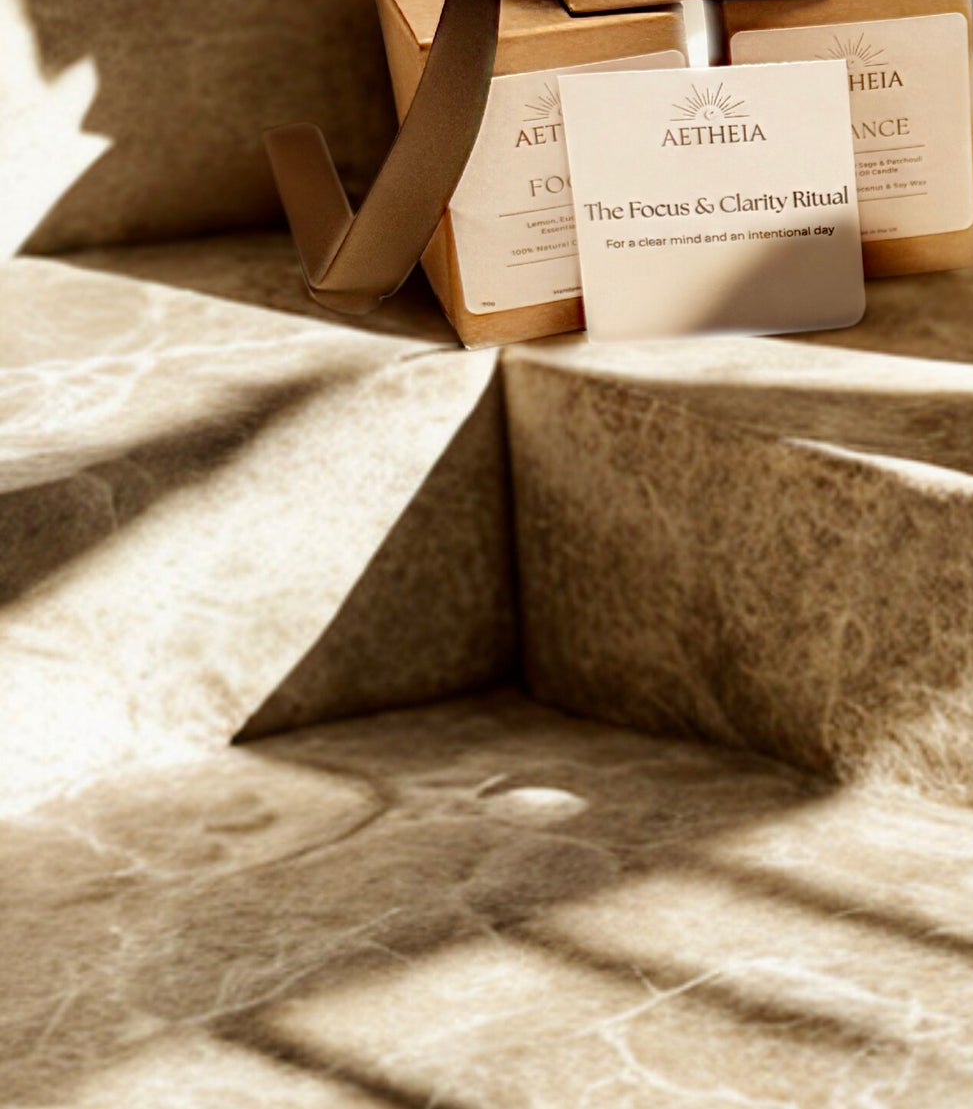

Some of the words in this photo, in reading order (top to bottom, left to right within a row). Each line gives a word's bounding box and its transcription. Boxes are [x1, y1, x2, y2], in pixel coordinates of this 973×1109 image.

[849, 70, 904, 92] HEIA
[661, 123, 767, 148] AETHEIA
[584, 201, 624, 221] The
[629, 201, 690, 218] Focus
[695, 197, 714, 215] &
[719, 193, 788, 214] Clarity
[792, 185, 849, 208] Ritual
[606, 238, 625, 249] For
[628, 239, 636, 248] a
[638, 236, 667, 247] clear
[670, 234, 701, 245] mind
[704, 232, 727, 243] and
[730, 232, 745, 241] an
[748, 227, 811, 240] intentional
[814, 225, 835, 237] day
